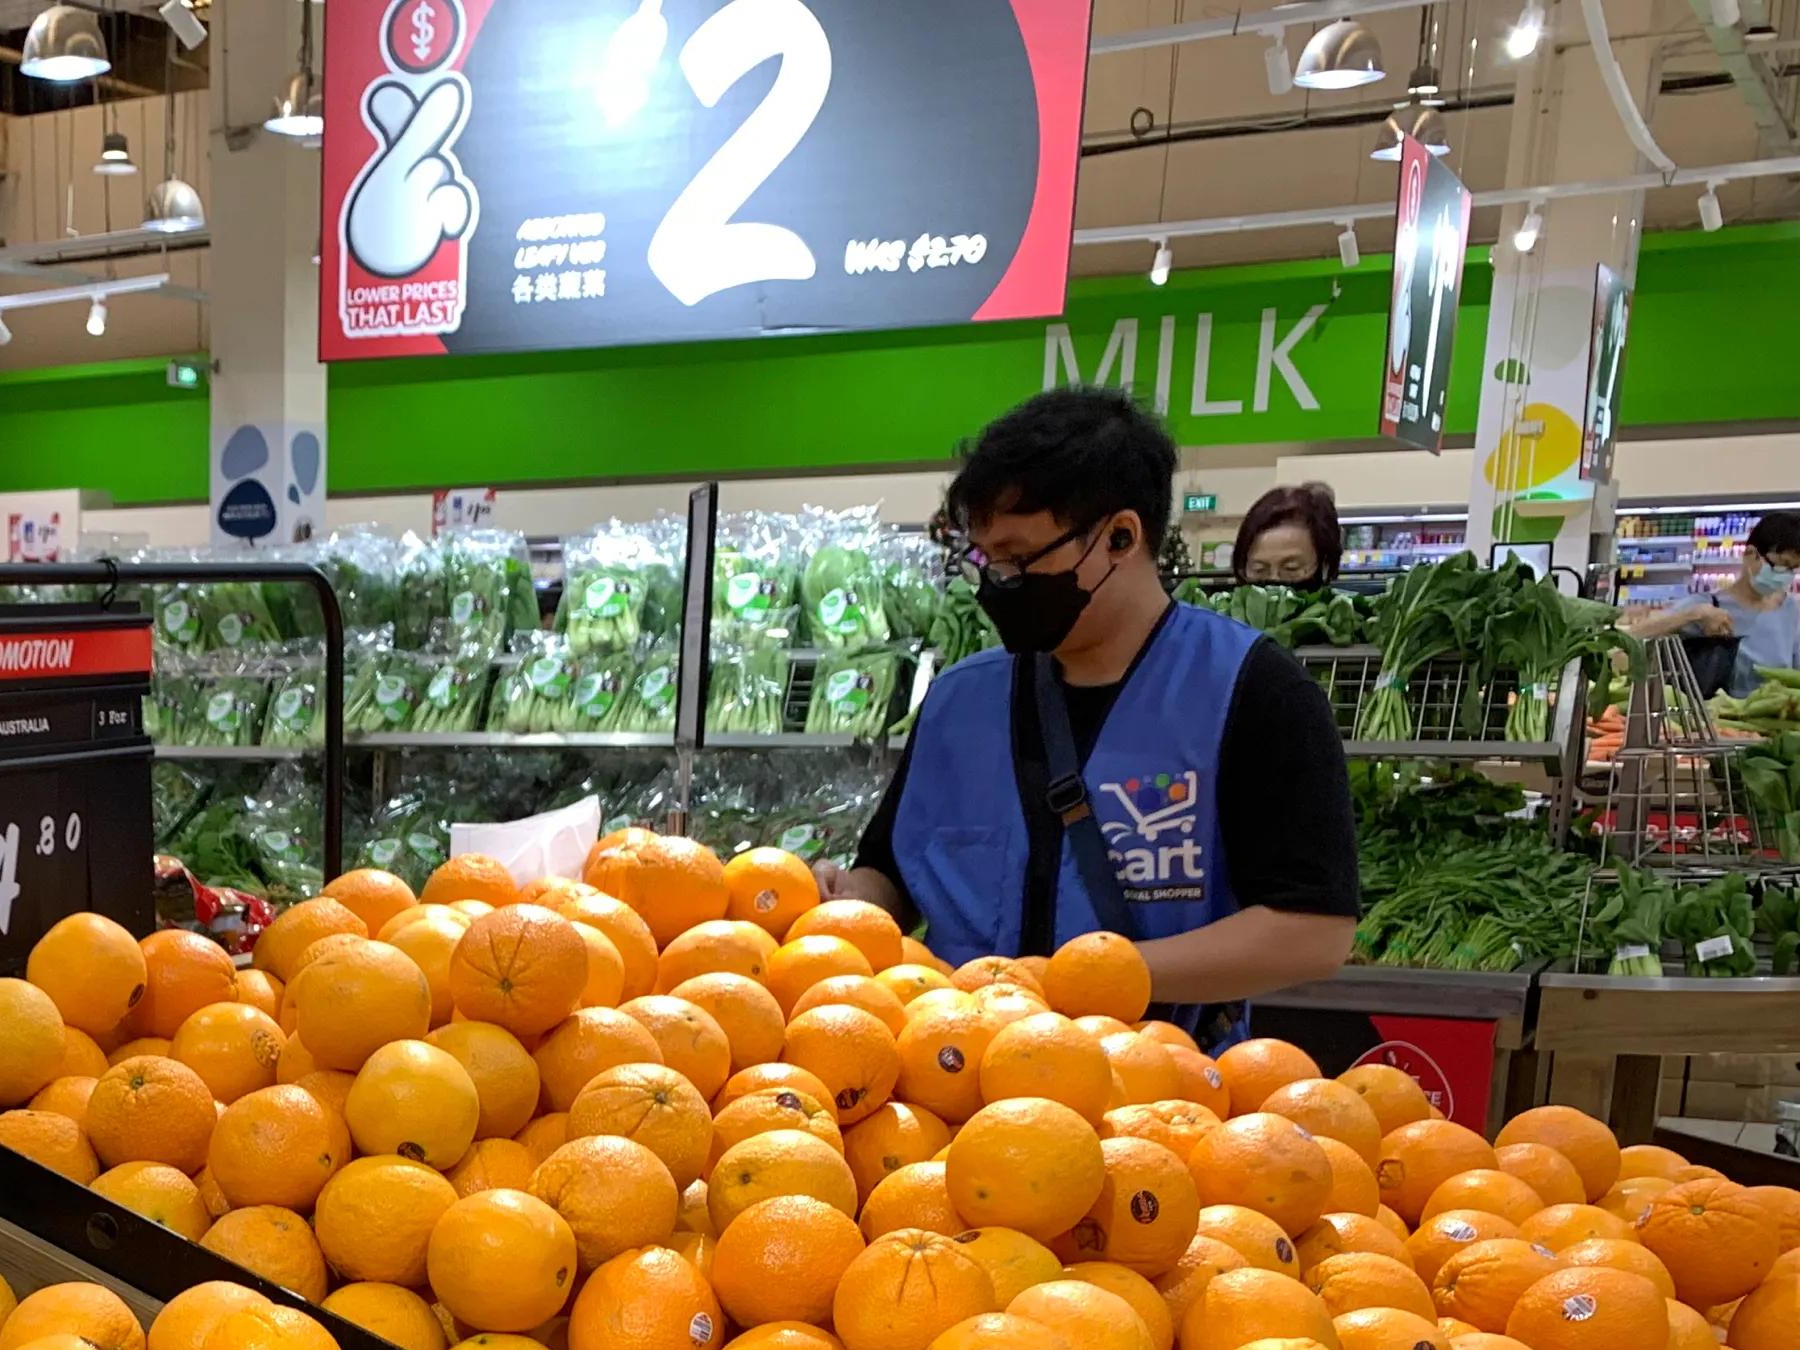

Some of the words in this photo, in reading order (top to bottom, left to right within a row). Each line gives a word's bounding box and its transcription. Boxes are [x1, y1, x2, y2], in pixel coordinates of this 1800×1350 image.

[648, 0, 832, 306] 2
[347, 286, 401, 305] LOWER
[402, 281, 458, 301] PRICES
[347, 306, 401, 330] THAT
[403, 301, 458, 326] LAST
[1042, 304, 1327, 418] MILK
[98, 711, 105, 726] 3
